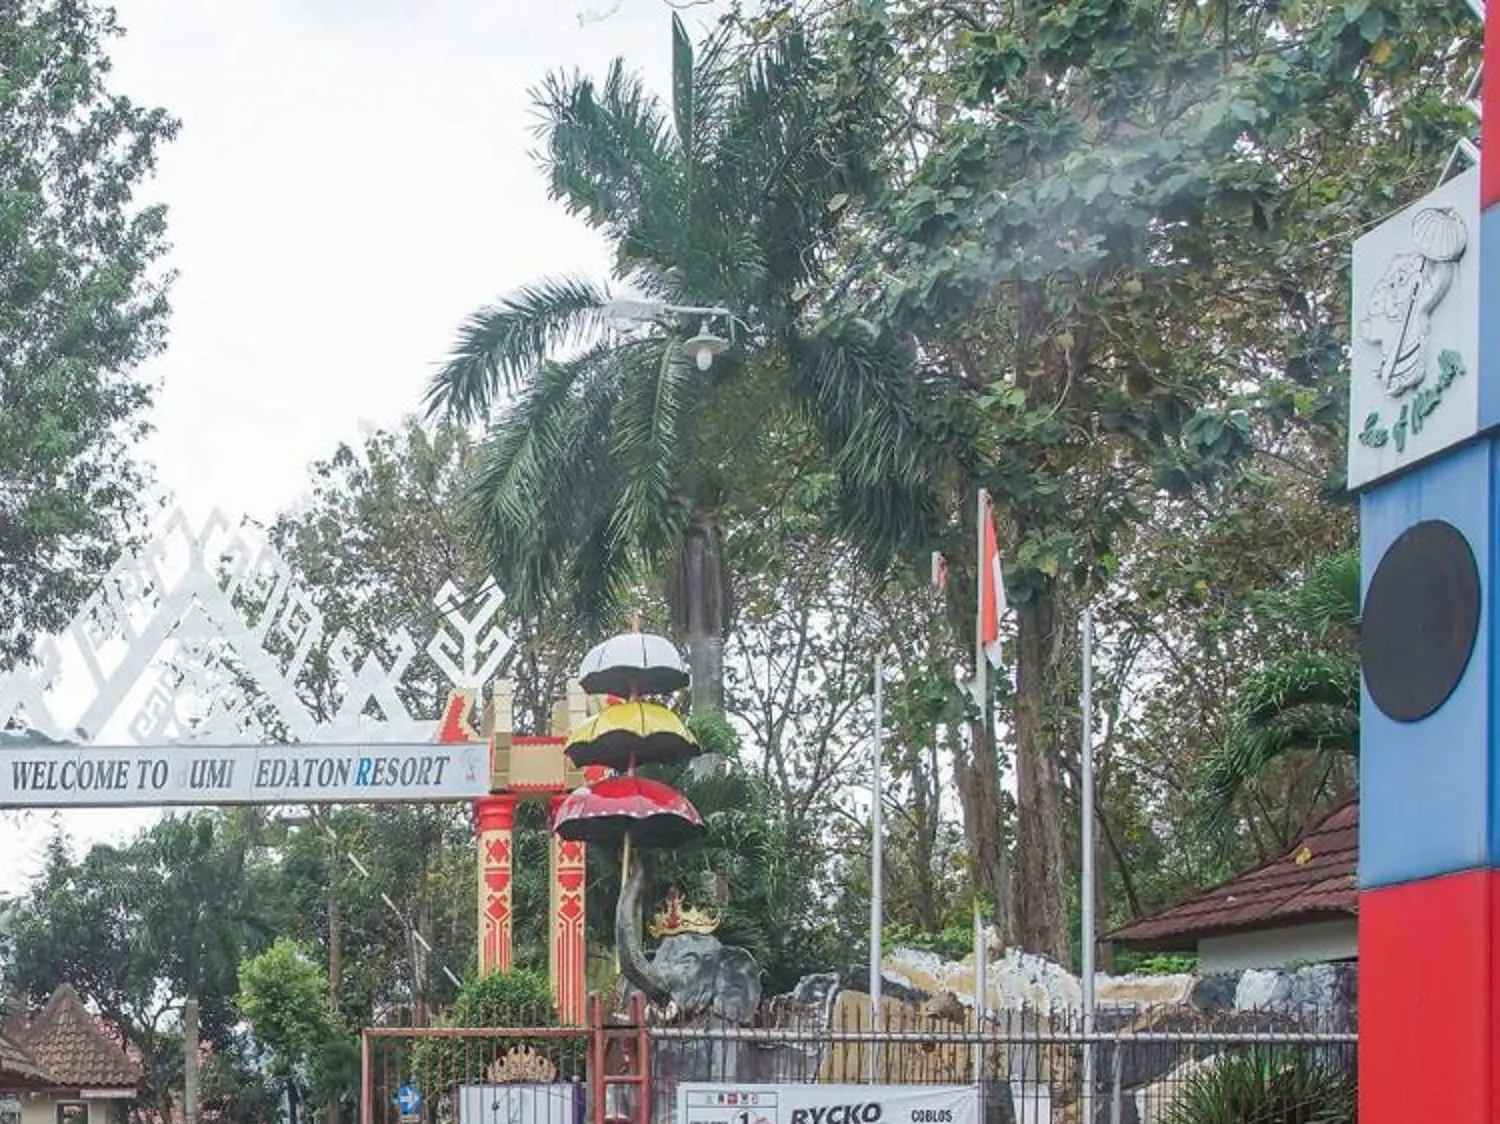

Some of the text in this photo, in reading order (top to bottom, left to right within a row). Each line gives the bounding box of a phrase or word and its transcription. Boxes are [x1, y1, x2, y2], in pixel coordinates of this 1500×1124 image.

[11, 759, 131, 791] WELCOME
[137, 759, 170, 790] TO
[354, 755, 451, 788] RESORT
[911, 1109, 953, 1123] COBLOS
